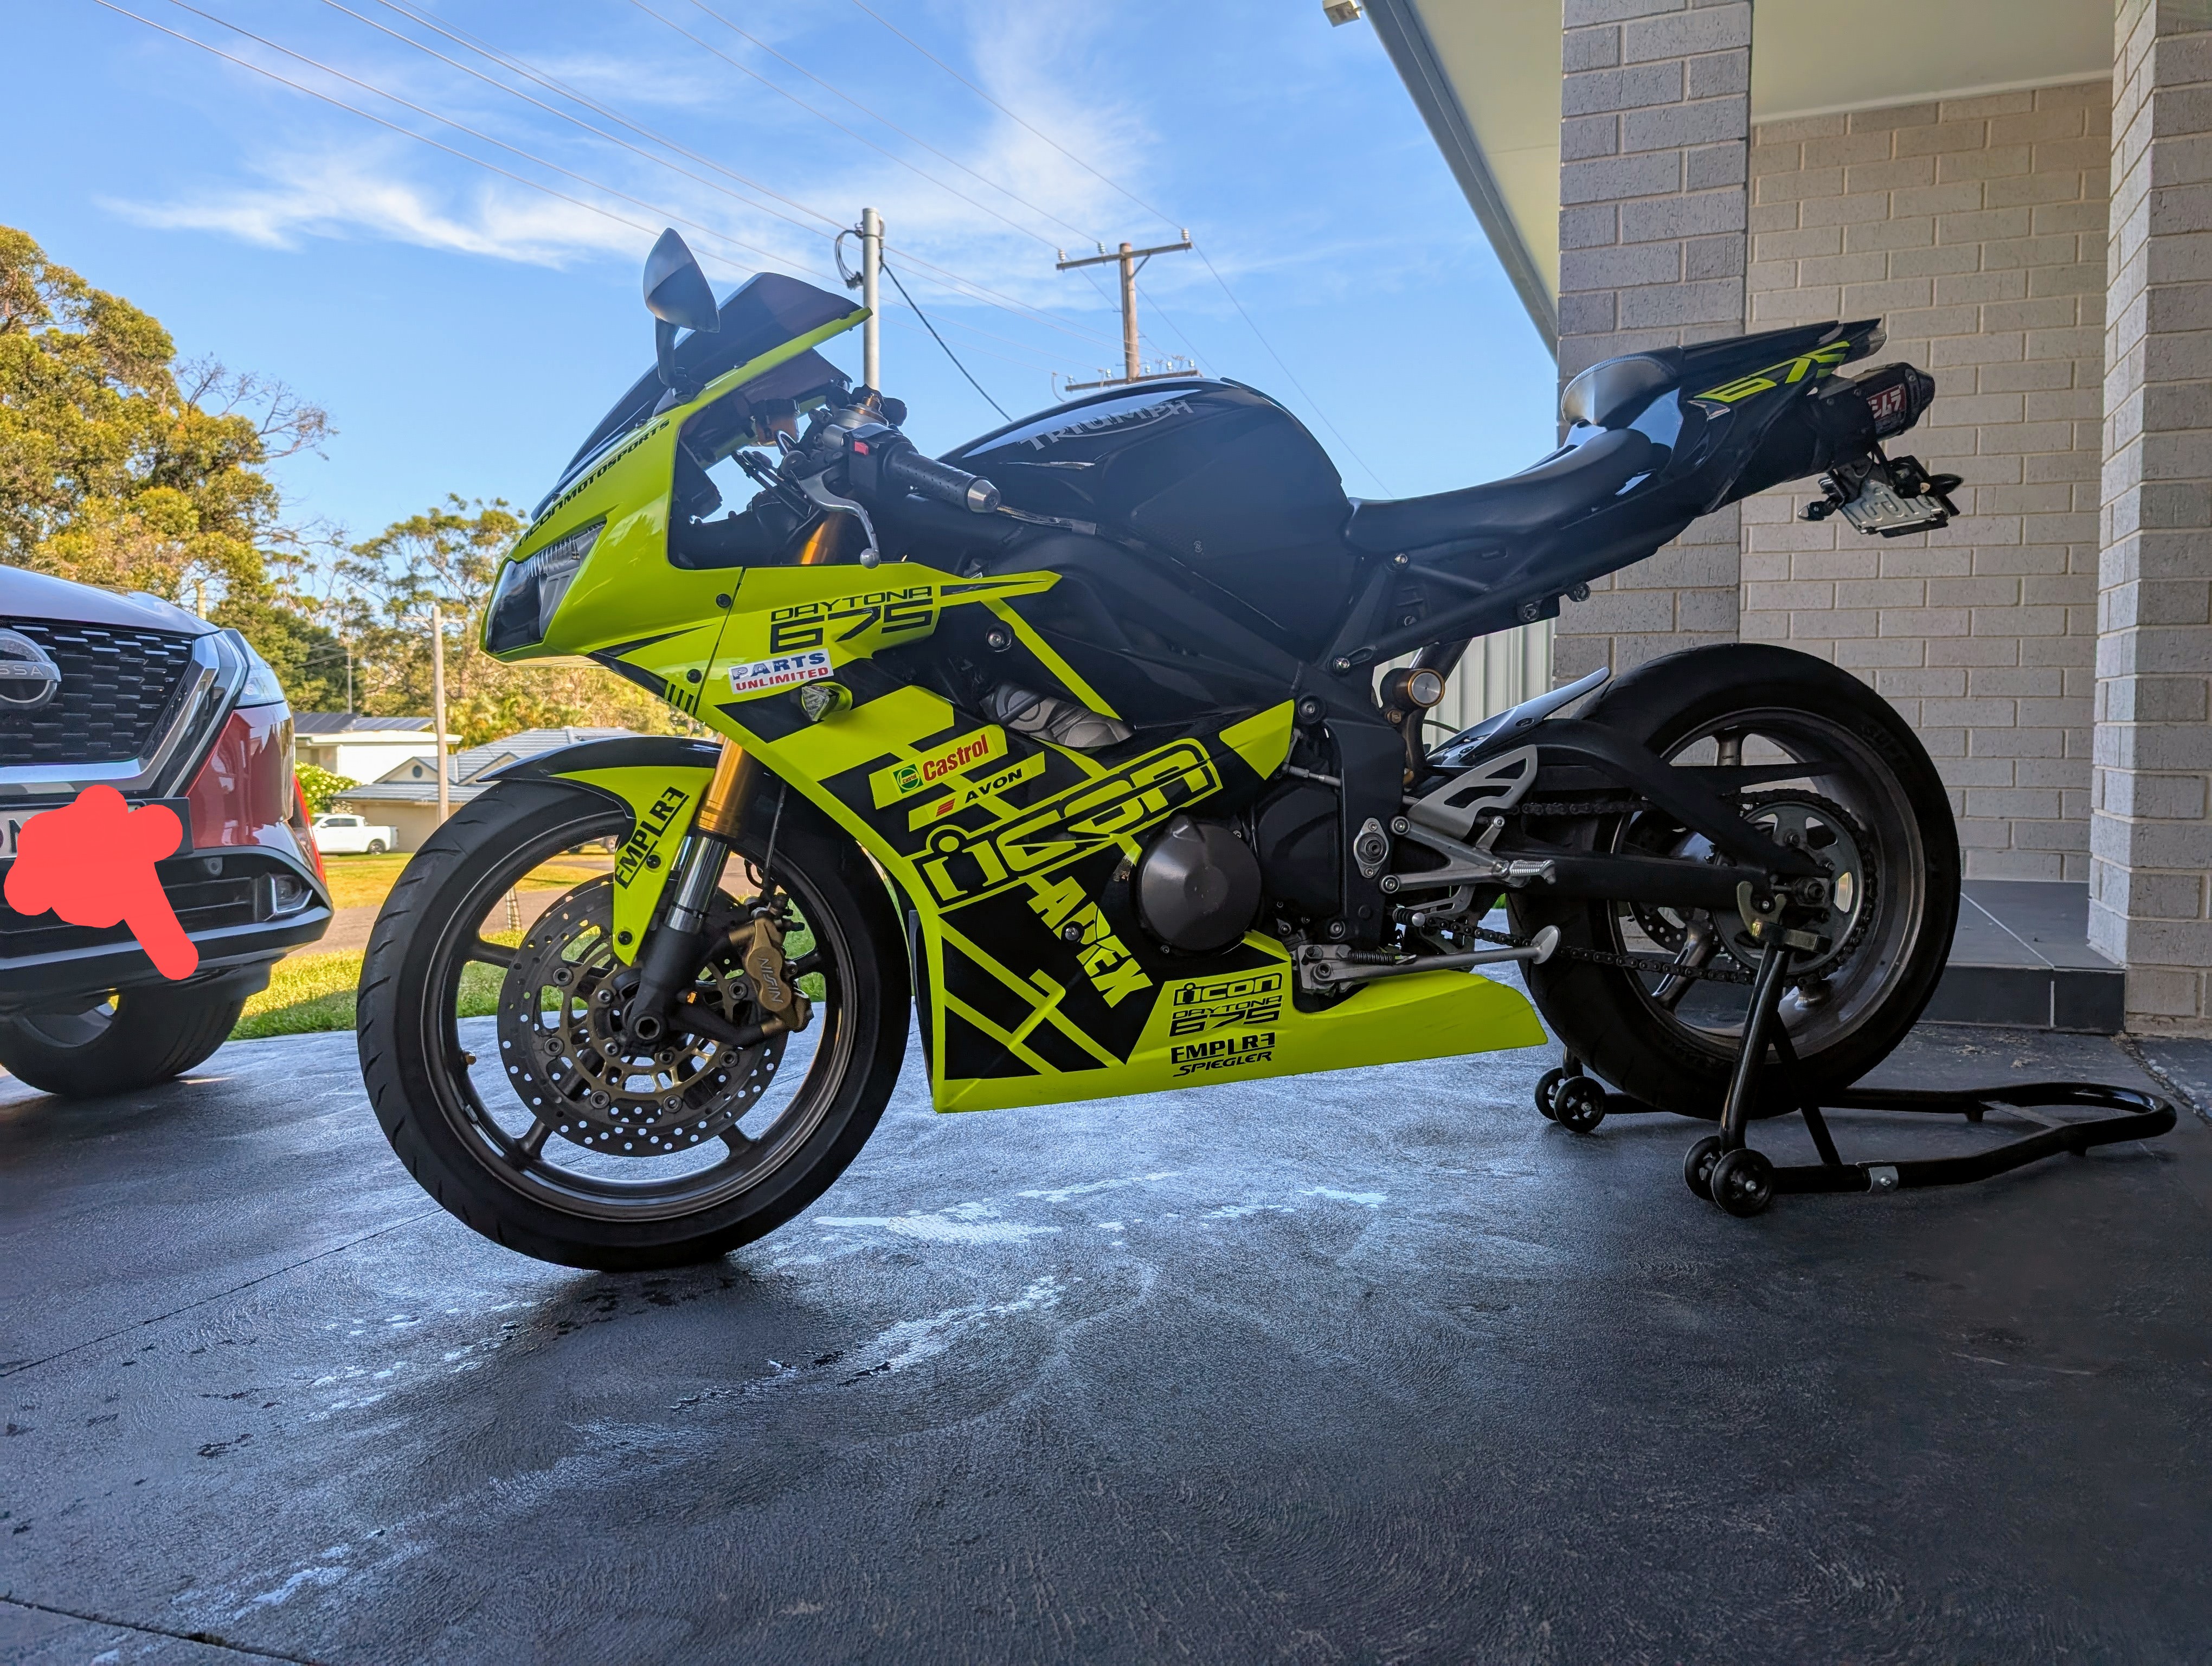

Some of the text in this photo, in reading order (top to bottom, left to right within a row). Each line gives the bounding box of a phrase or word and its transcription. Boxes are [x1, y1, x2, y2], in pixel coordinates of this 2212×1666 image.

[1017, 400, 1194, 451] TRIUMPH
[770, 586, 932, 623] DAYTONA
[770, 598, 933, 654] 675
[731, 652, 825, 680] PARTS
[736, 667, 829, 691] UNLIMITED
[923, 733, 989, 781] Castrol
[964, 768, 1023, 804] AVON
[1027, 876, 1153, 1008] APEX
[1169, 1003, 1282, 1037] 675
[1172, 995, 1283, 1020] DAYTONA
[1172, 1050, 1272, 1078] SPIEGLER
